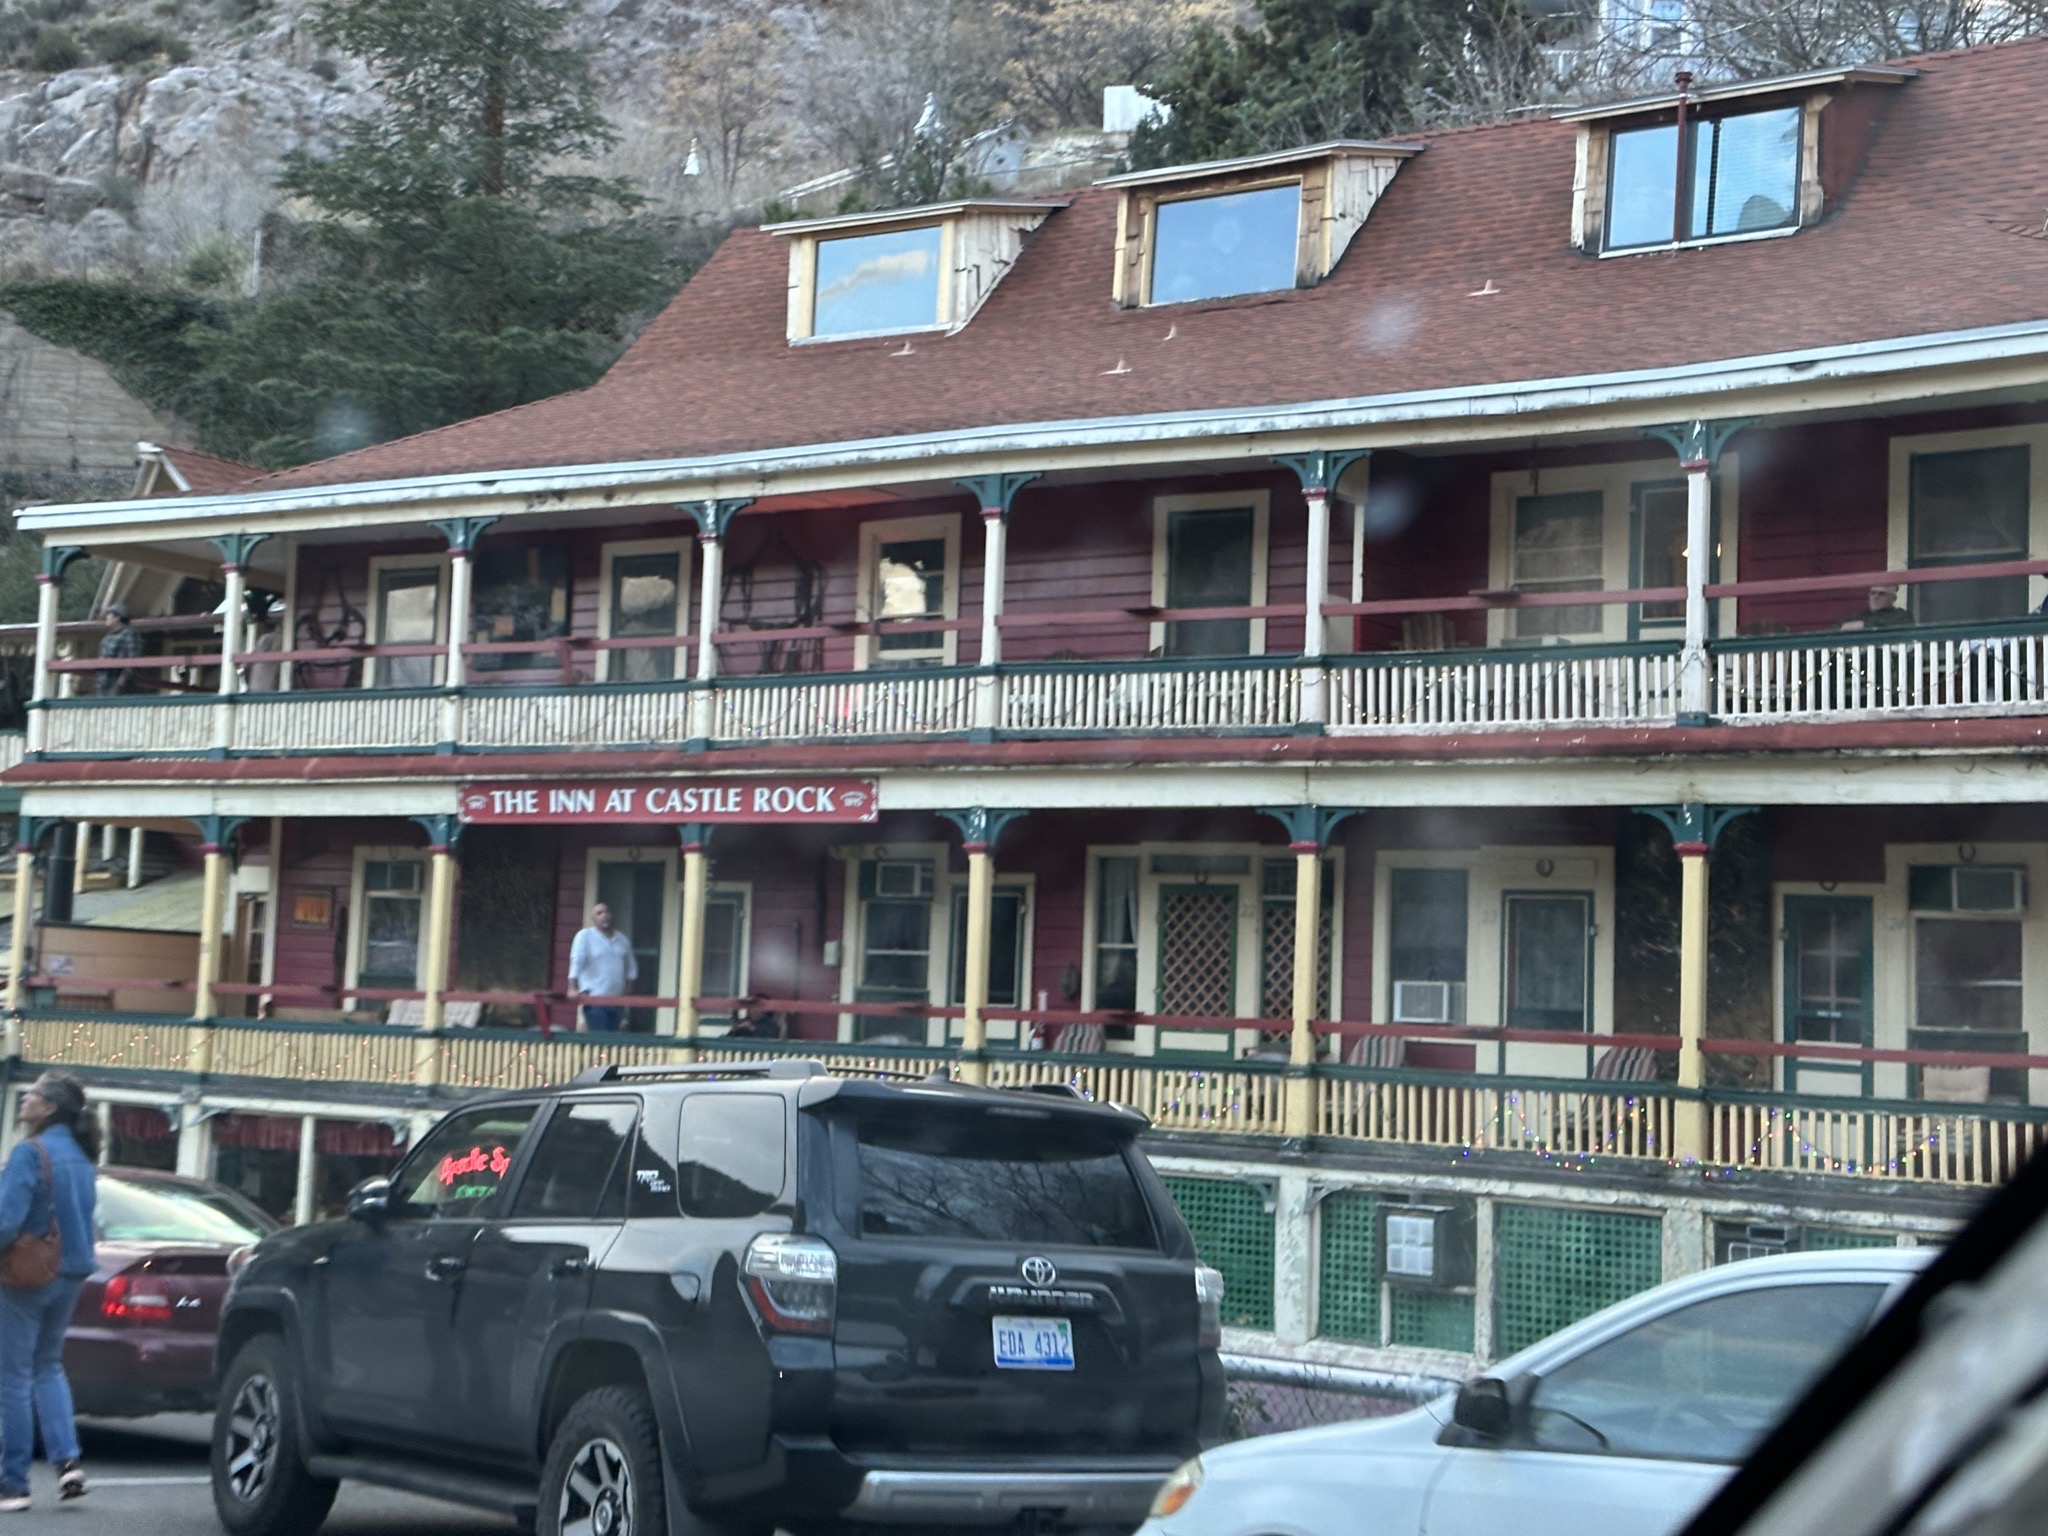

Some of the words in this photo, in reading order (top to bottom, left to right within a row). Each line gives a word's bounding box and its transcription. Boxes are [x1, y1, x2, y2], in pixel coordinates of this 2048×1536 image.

[489, 789, 540, 814] THE
[548, 788, 596, 814] INN
[603, 788, 637, 813] AT
[645, 787, 743, 814] CASTLE
[752, 786, 836, 813] ROCK
[999, 1330, 1025, 1356] EDA
[1035, 1330, 1069, 1359] 4312
